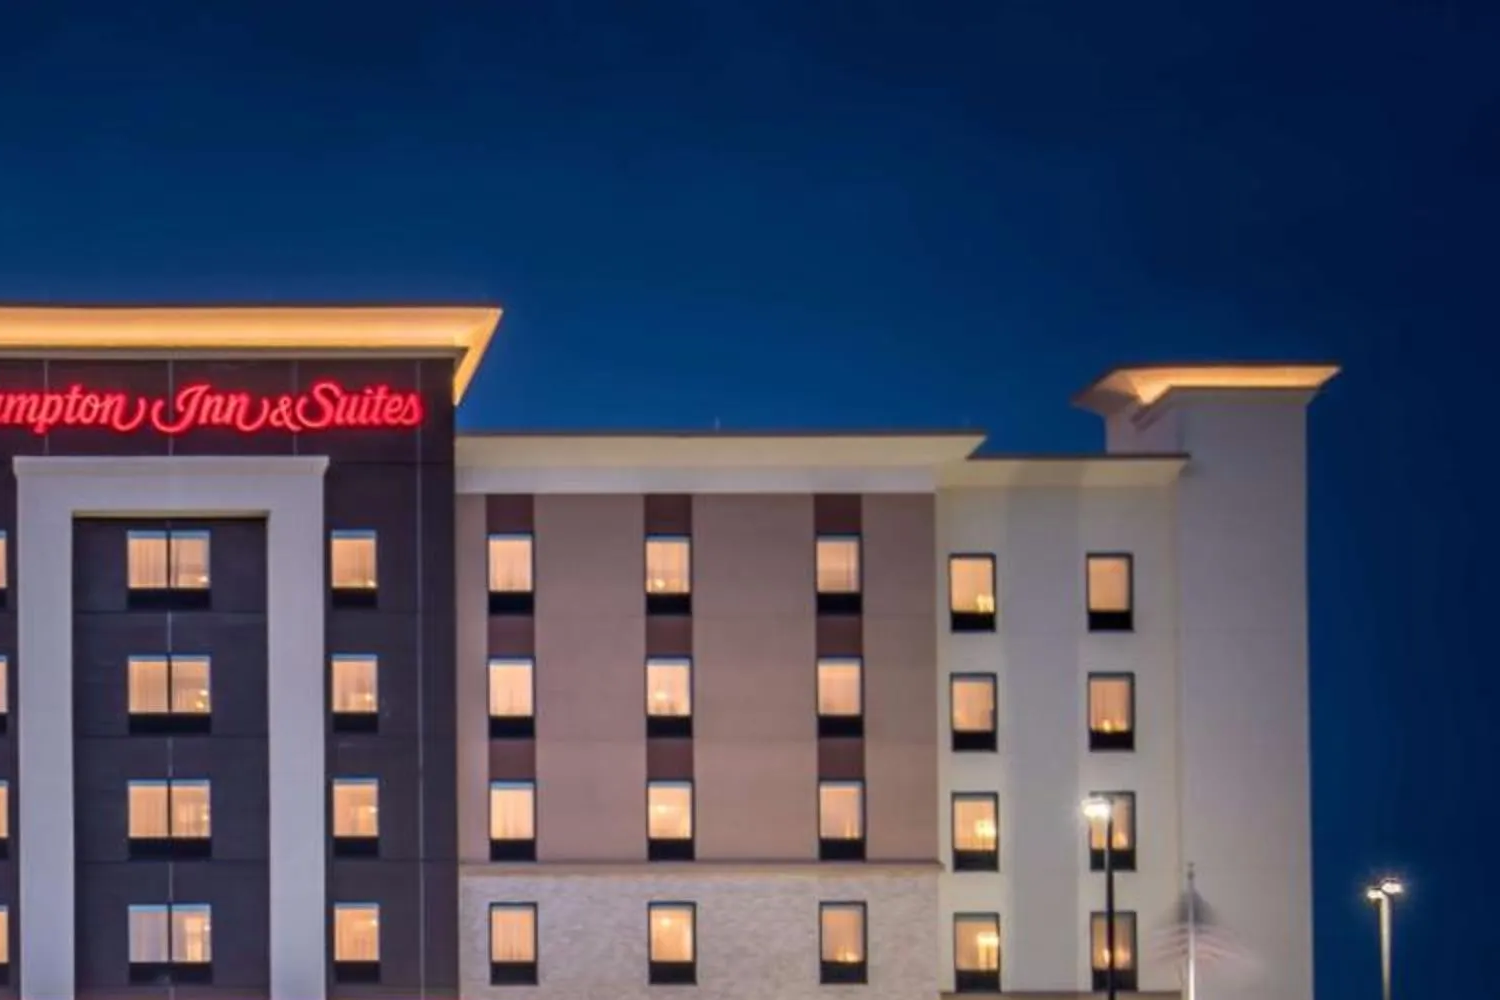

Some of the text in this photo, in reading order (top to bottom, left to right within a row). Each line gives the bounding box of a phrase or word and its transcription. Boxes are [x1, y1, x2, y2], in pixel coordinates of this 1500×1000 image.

[150, 383, 270, 434] Inn
[269, 395, 303, 432] &
[295, 382, 423, 428] Suites
